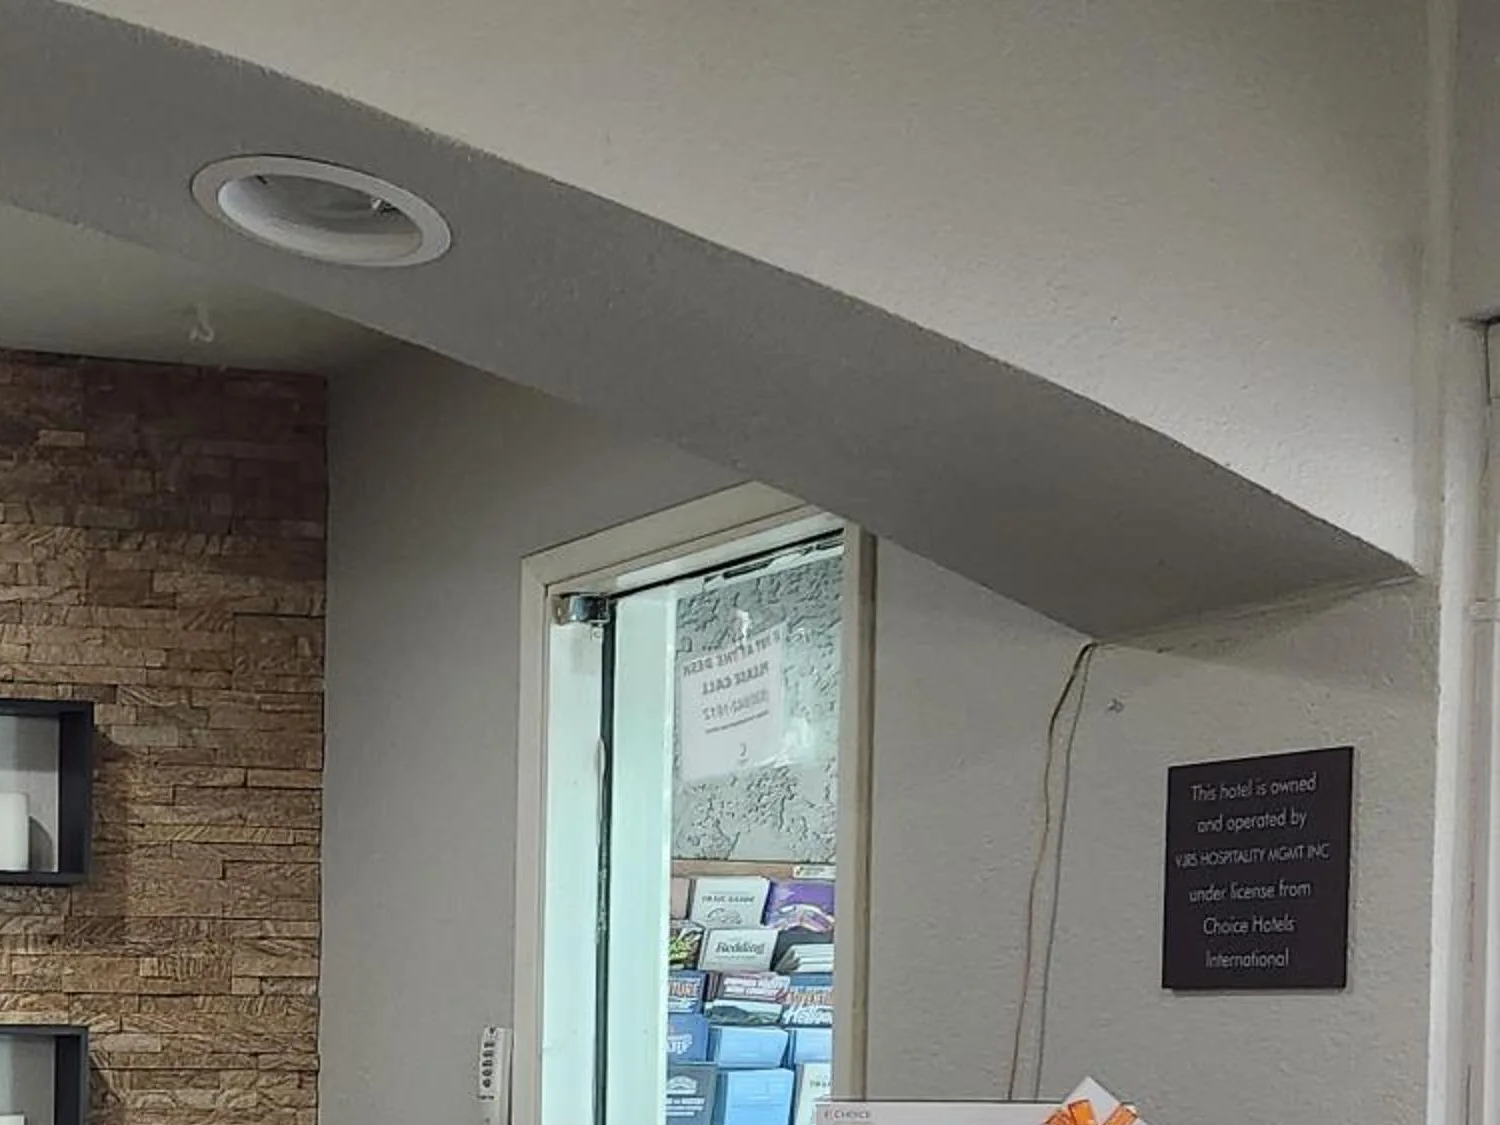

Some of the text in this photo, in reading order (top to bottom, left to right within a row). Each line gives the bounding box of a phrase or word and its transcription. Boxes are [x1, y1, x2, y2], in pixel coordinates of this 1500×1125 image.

[1190, 772, 1316, 801] This hotel is owned
[1197, 808, 1307, 833] and operated by
[1200, 848, 1266, 866] HOSPITALITY
[1268, 845, 1303, 862] MGMT
[1307, 843, 1330, 859] INC
[1189, 879, 1311, 902] under license from
[1203, 914, 1296, 935] Choice Hotels
[1205, 949, 1289, 968] International
